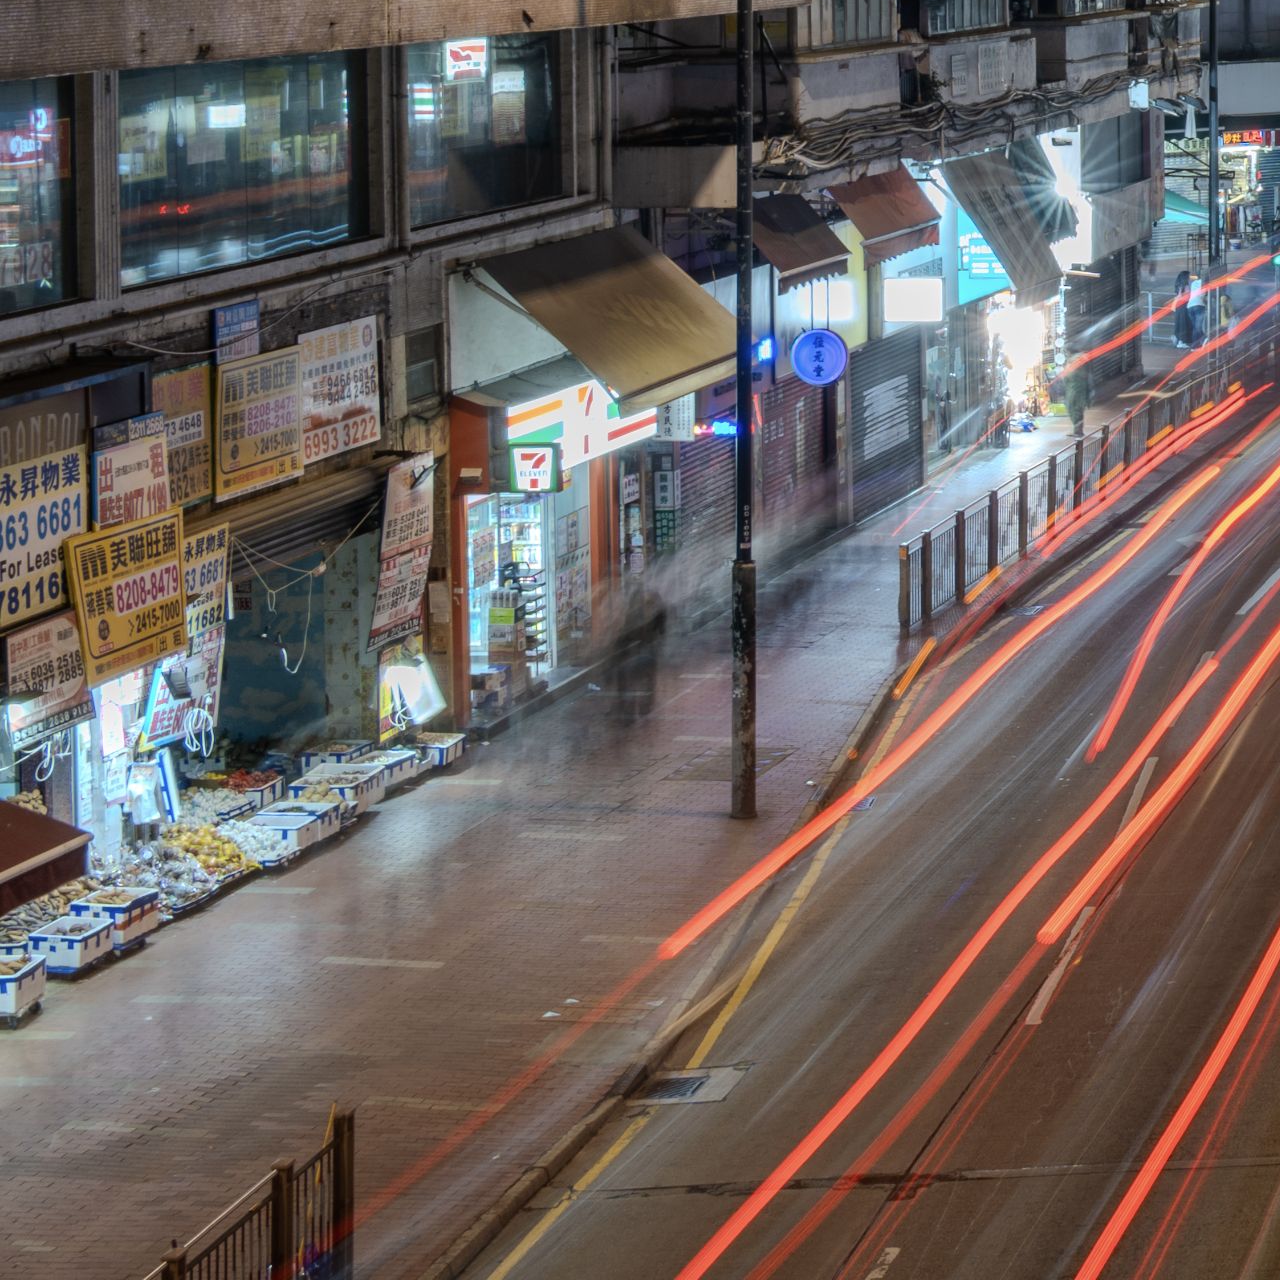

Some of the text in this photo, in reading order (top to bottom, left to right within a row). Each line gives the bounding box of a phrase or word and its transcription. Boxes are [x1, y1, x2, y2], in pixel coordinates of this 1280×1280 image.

[178, 414, 202, 433] 4648
[304, 414, 378, 459] 6993 3222
[0, 452, 81, 507] 永昇物業
[37, 492, 82, 540] 6681
[184, 527, 225, 563] 永昇物業
[0, 543, 67, 583] For Lease
[199, 555, 224, 588] 6681
[115, 564, 180, 614] 8208-8479
[135, 599, 180, 634] 2415-7000
[187, 603, 223, 635] 11682
[158, 636, 169, 653] 出
[30, 649, 82, 680] 6036 2518
[58, 663, 85, 686] 2885
